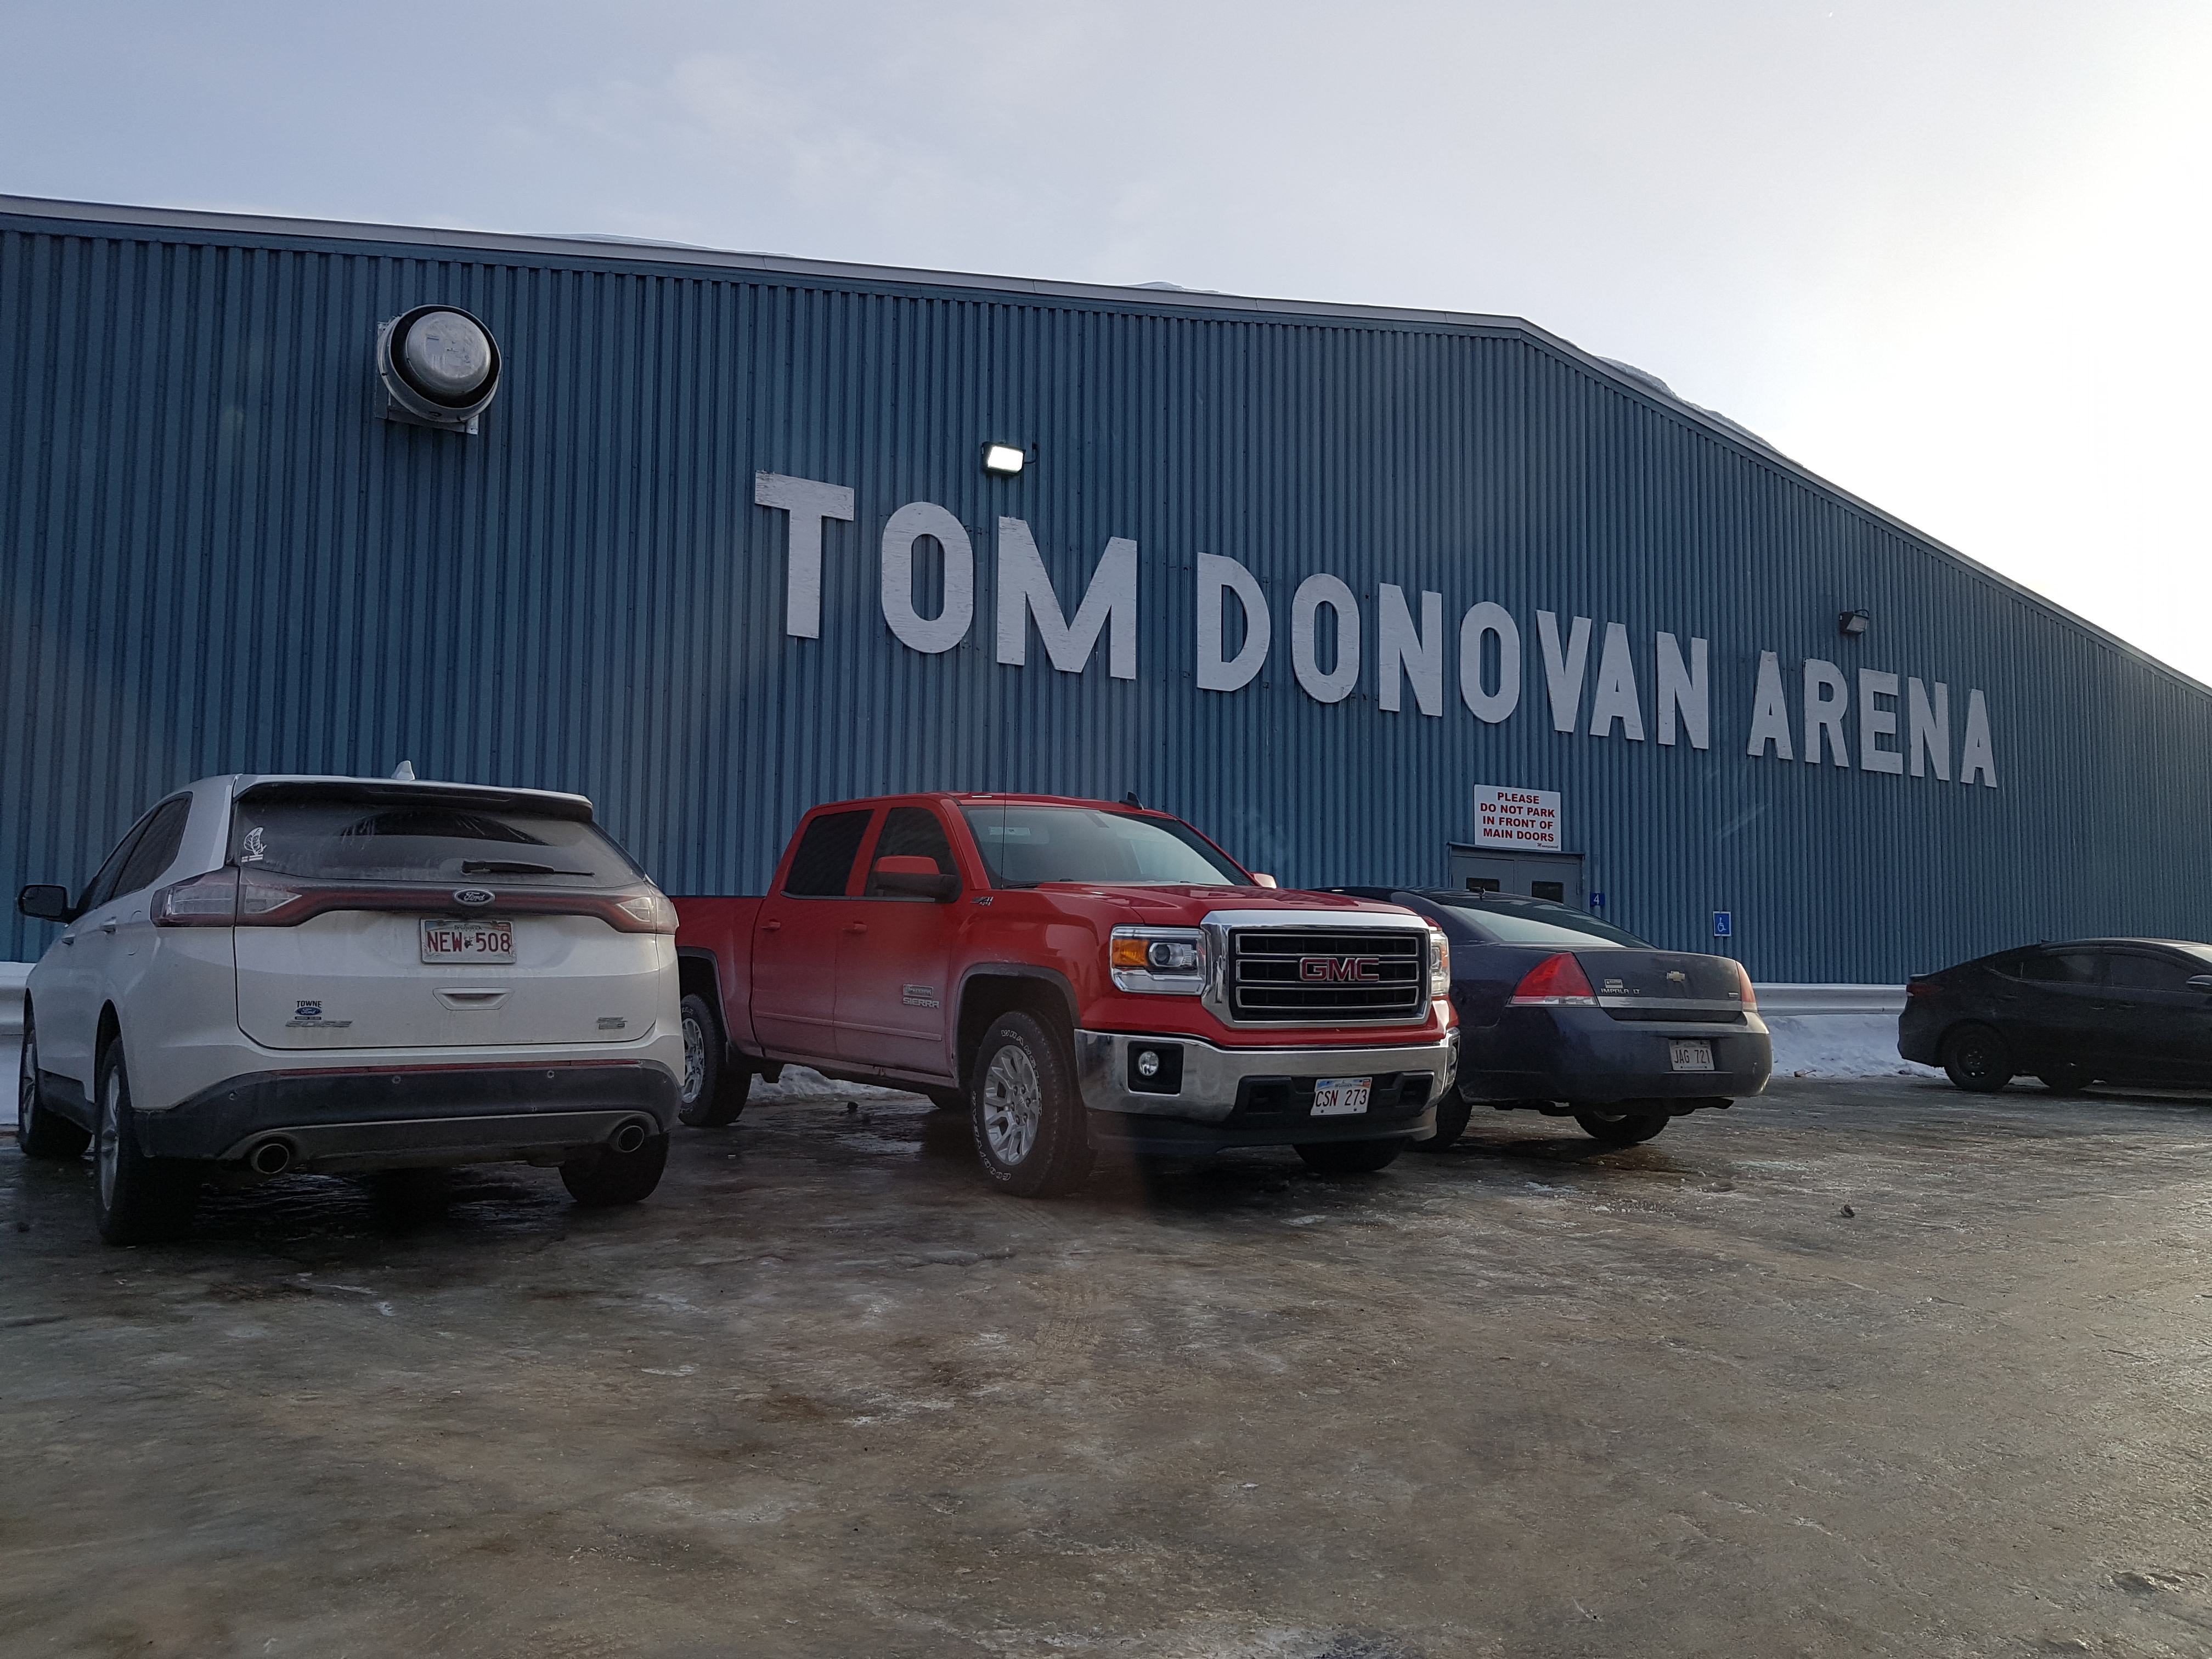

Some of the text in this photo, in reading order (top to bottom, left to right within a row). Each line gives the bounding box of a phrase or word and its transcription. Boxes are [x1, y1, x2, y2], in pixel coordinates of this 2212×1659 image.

[755, 470, 1997, 788] TOM DONOVAN ARENA
[1497, 792, 1539, 804] PLEASE
[1480, 803, 1555, 818] DO NOT PARK
[1483, 815, 1553, 830] IN FRONT OF
[1483, 828, 1554, 842] MAIN DOORS
[463, 891, 486, 901] Ford
[1593, 894, 1600, 905] 4
[427, 932, 511, 952] NEW 508
[1299, 957, 1379, 981] GMC
[297, 1000, 323, 1008] TOWNE
[903, 997, 940, 1009] SIERRA
[1674, 1049, 1711, 1064] JAG 721
[1316, 1089, 1367, 1107] CSN 273
